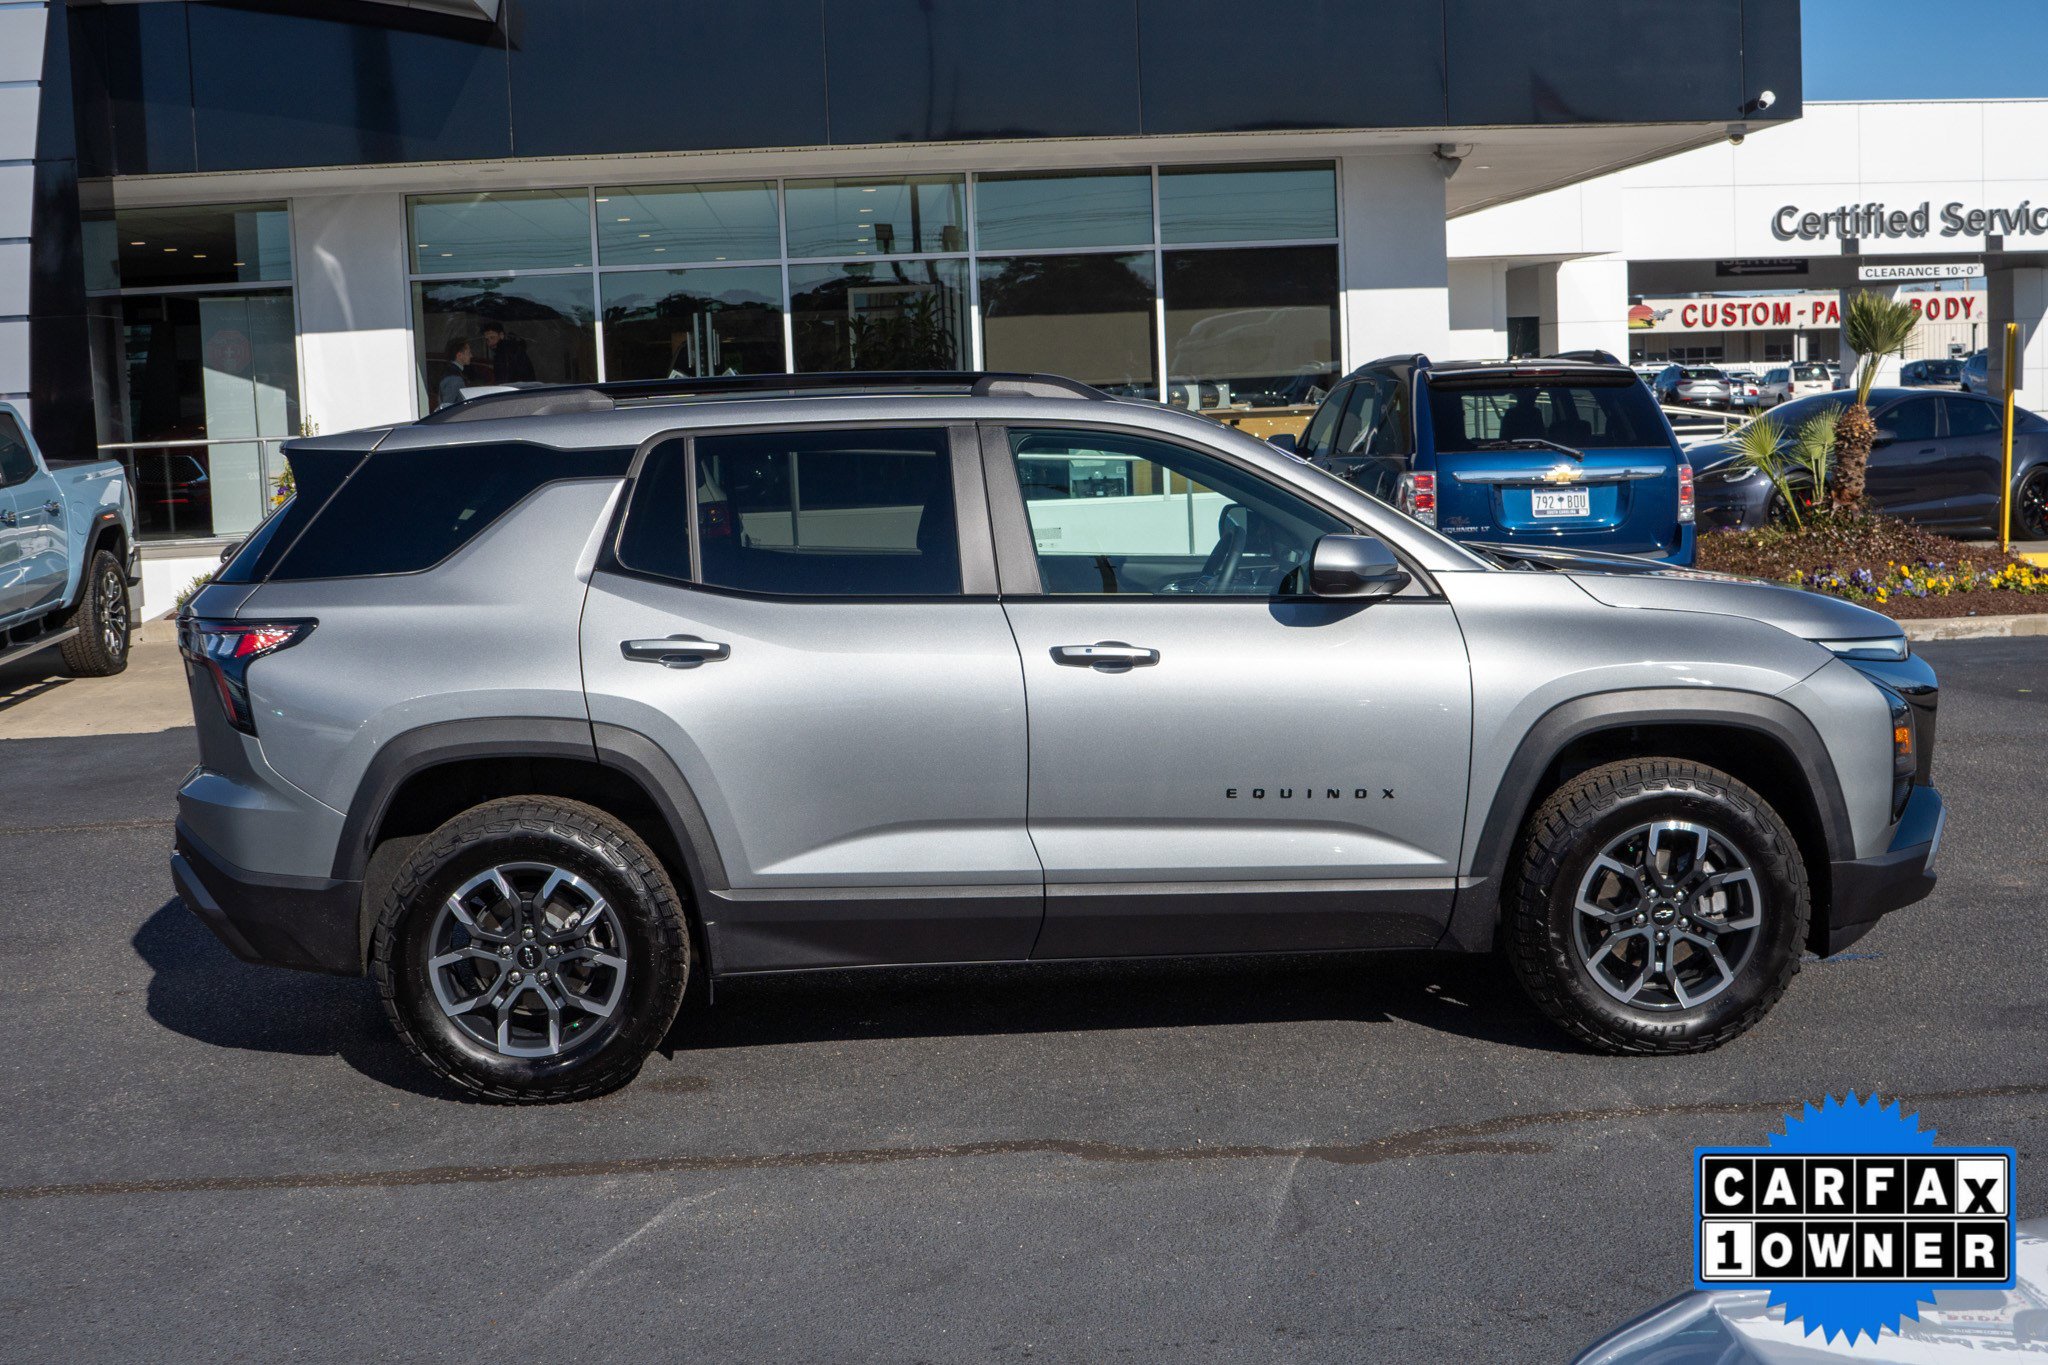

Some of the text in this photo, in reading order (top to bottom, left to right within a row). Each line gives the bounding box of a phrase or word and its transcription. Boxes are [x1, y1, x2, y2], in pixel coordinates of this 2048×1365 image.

[1772, 201, 1930, 241] Certified
[1865, 267, 1941, 278] CLEARANCE
[1536, 495, 1554, 509] 792
[1226, 788, 1395, 799] EQUINOX
